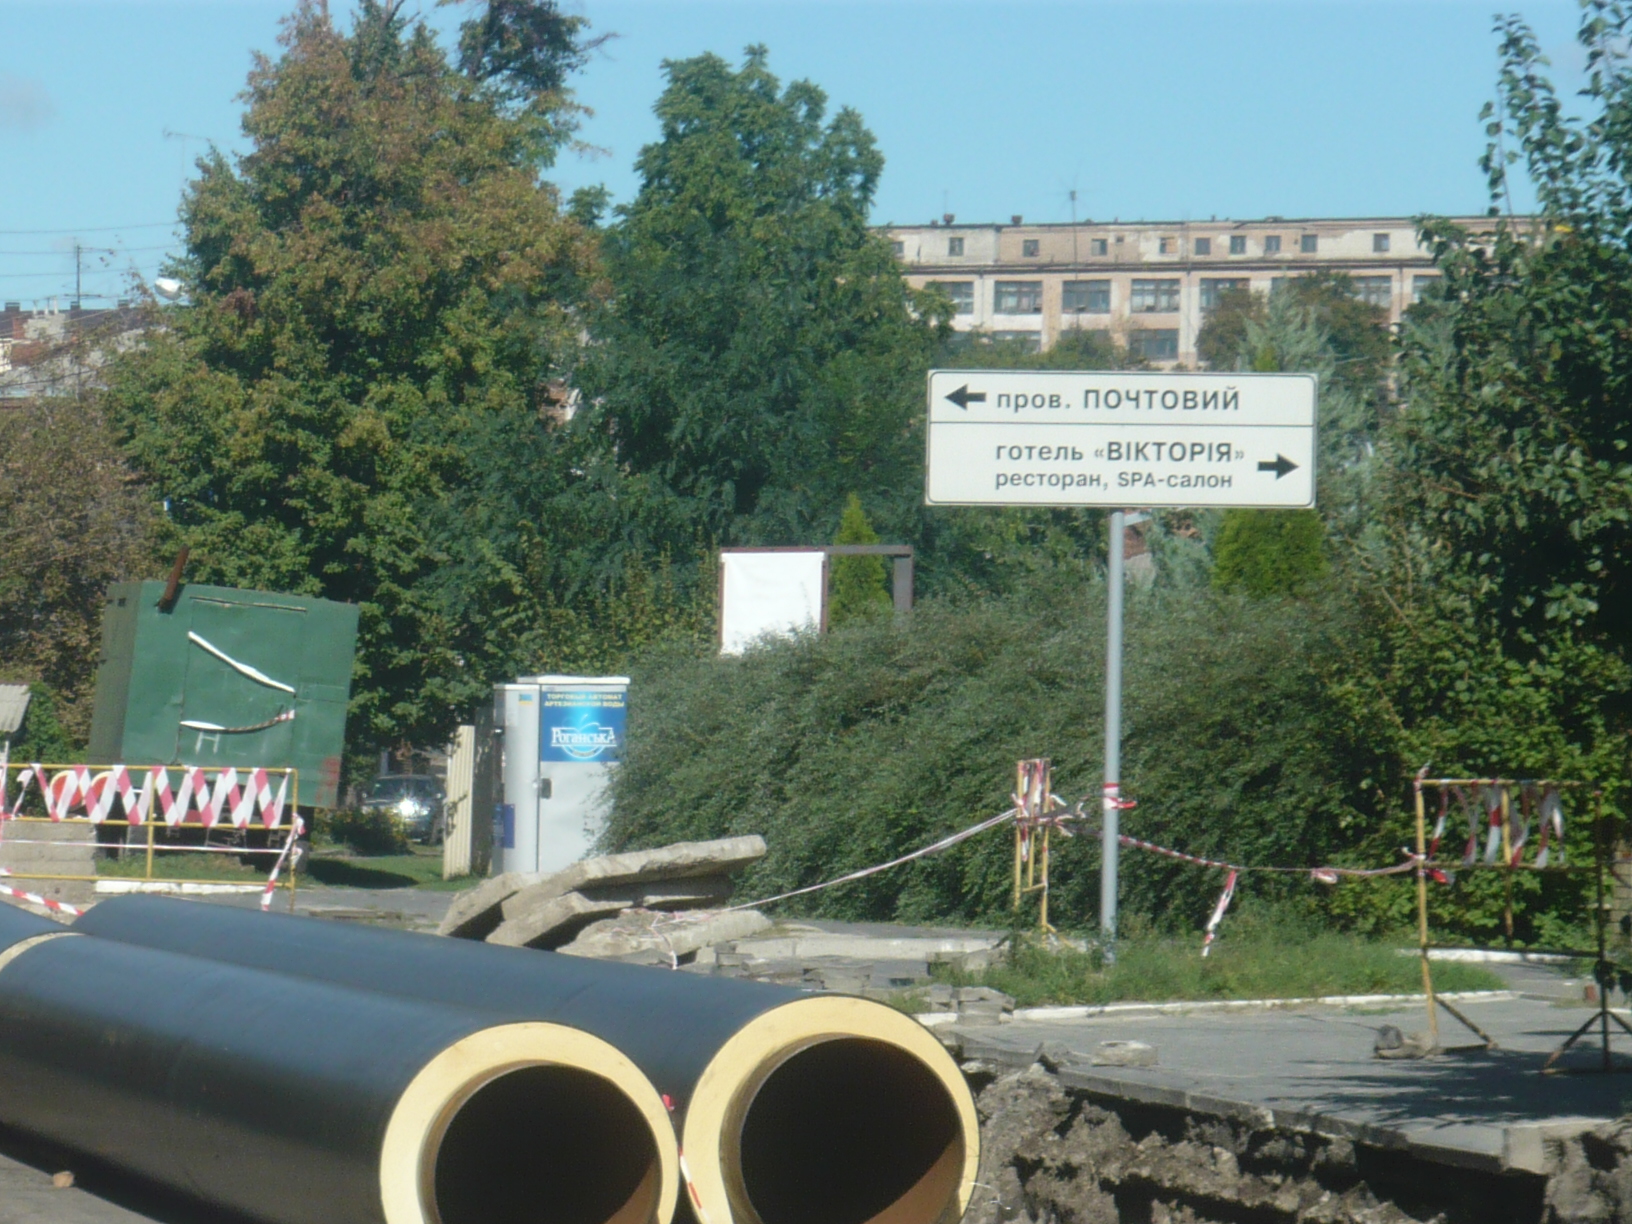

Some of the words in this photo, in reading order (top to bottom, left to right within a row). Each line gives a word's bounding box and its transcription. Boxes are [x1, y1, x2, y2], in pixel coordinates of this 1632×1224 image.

[996, 391, 1072, 413] пров.
[1084, 386, 1240, 411] ПОЧТОВИЙ
[996, 444, 1083, 462] готель
[1094, 441, 1245, 463] «ВІКТОРІЯ»
[995, 472, 1109, 490] ресторан,
[1118, 471, 1232, 489] SPA-салон
